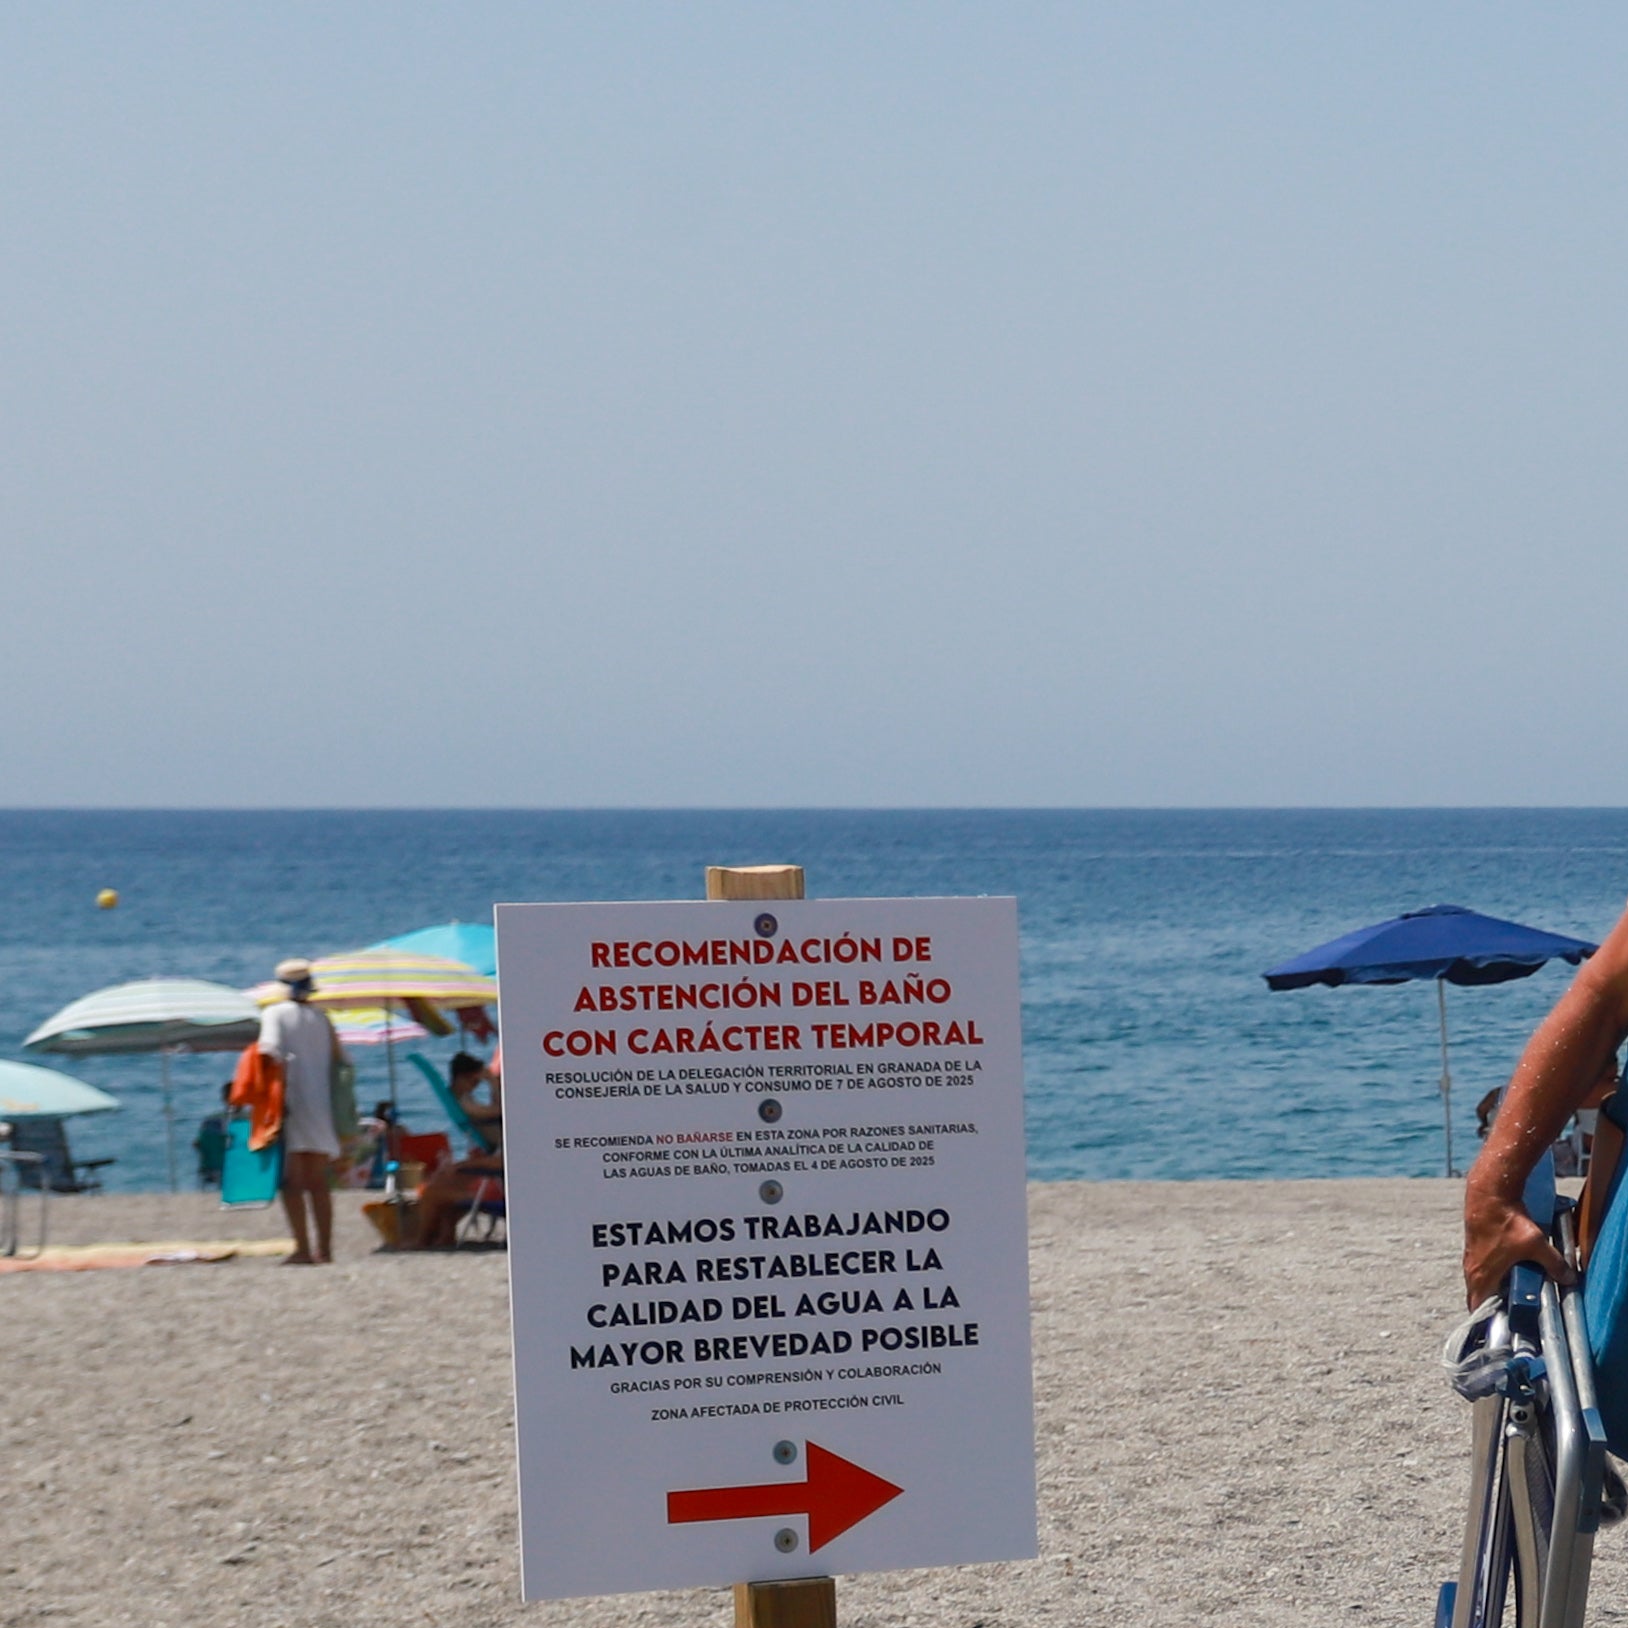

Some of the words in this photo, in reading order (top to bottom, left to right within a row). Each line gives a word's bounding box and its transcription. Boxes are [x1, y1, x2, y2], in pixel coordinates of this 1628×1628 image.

[591, 932, 882, 968] RECOMENDACIÓN
[892, 936, 931, 962] DE
[573, 975, 781, 1012] ABSTENCIÓN
[791, 980, 850, 1007] DEL
[859, 972, 951, 1005] BAÑO
[542, 1029, 616, 1057] CON
[627, 1020, 802, 1055] CARÁCTER
[810, 1020, 984, 1049] TEMPORAL
[545, 1068, 633, 1084] RESOLUCIÓN
[636, 1069, 655, 1081] DE
[658, 1069, 676, 1081] LA
[678, 1064, 764, 1080] DELEGACIÓN
[767, 1063, 853, 1077] TERRITORIAL
[856, 1062, 874, 1074] EN
[877, 1061, 942, 1074] GRANADA
[944, 1060, 962, 1072] DE
[964, 1059, 982, 1071] LA
[554, 1083, 641, 1099] CONSEJERÍA
[643, 1084, 662, 1096] DE
[664, 1083, 683, 1095] LA
[685, 1081, 730, 1095] SALUD
[732, 1081, 742, 1093] Y
[744, 1079, 812, 1093] CONSUMO
[815, 1078, 833, 1090] DE
[836, 1078, 843, 1089] 7
[846, 1077, 865, 1090] DE
[867, 1076, 922, 1089] AGOSTO
[924, 1075, 943, 1087] DE
[945, 1074, 974, 1086] 2025
[554, 1137, 571, 1149] SE
[573, 1134, 654, 1148] RECOMIENDA
[655, 1134, 674, 1145] NO
[676, 1131, 733, 1144] BAÑARSE
[736, 1131, 752, 1142] EN
[754, 1129, 785, 1141] ESTA
[787, 1128, 820, 1140] ZONA
[822, 1127, 848, 1138] POR
[850, 1125, 905, 1137] RAZONES
[908, 1123, 978, 1135] SANITARIAS,
[602, 1149, 670, 1163] CONFORME
[672, 1148, 699, 1160] CON
[701, 1148, 718, 1159] LA
[719, 1145, 763, 1158] ÚLTIMA
[764, 1143, 826, 1156] ANALÍTICA
[828, 1143, 844, 1154] DE
[847, 1142, 863, 1153] LA
[864, 1140, 916, 1153] CALIDAD
[918, 1139, 934, 1151] DE
[602, 1167, 627, 1179] LAS
[628, 1166, 671, 1178] AGUAS
[674, 1165, 690, 1176] DE
[693, 1162, 730, 1175] BAÑO,
[732, 1160, 791, 1173] TOMADAS
[793, 1160, 808, 1171] EL
[810, 1160, 818, 1170] 4
[820, 1159, 837, 1170] DE
[838, 1157, 888, 1169] AGOSTO
[890, 1156, 907, 1167] DE
[909, 1155, 935, 1166] 2025
[592, 1217, 735, 1248] ESTAMOS
[743, 1208, 950, 1240] TRABAJANDO
[602, 1260, 687, 1287] PARA
[696, 1249, 897, 1282] RESTABLECER
[906, 1247, 943, 1272] LA
[586, 1298, 723, 1328] CALIDAD
[732, 1294, 786, 1320] DEL
[794, 1289, 884, 1317] AGUA
[892, 1287, 914, 1311] A
[923, 1285, 960, 1309] LA
[570, 1340, 685, 1369] MAYOR
[694, 1330, 852, 1362] BREVEDAD
[861, 1322, 979, 1352] POSIBLE
[610, 1379, 670, 1394] GRACIAS
[673, 1377, 702, 1390] POR
[705, 1375, 723, 1388] SU
[726, 1368, 823, 1386] COMPRENSIÓN
[825, 1369, 834, 1380] Y
[837, 1361, 941, 1380] COLABORACIÓN
[651, 1407, 689, 1421] ZONA
[690, 1403, 760, 1418] AFECTADA
[762, 1401, 781, 1413] DE
[784, 1394, 868, 1412] PROTECCIÓN
[871, 1394, 904, 1406] CIVIL
